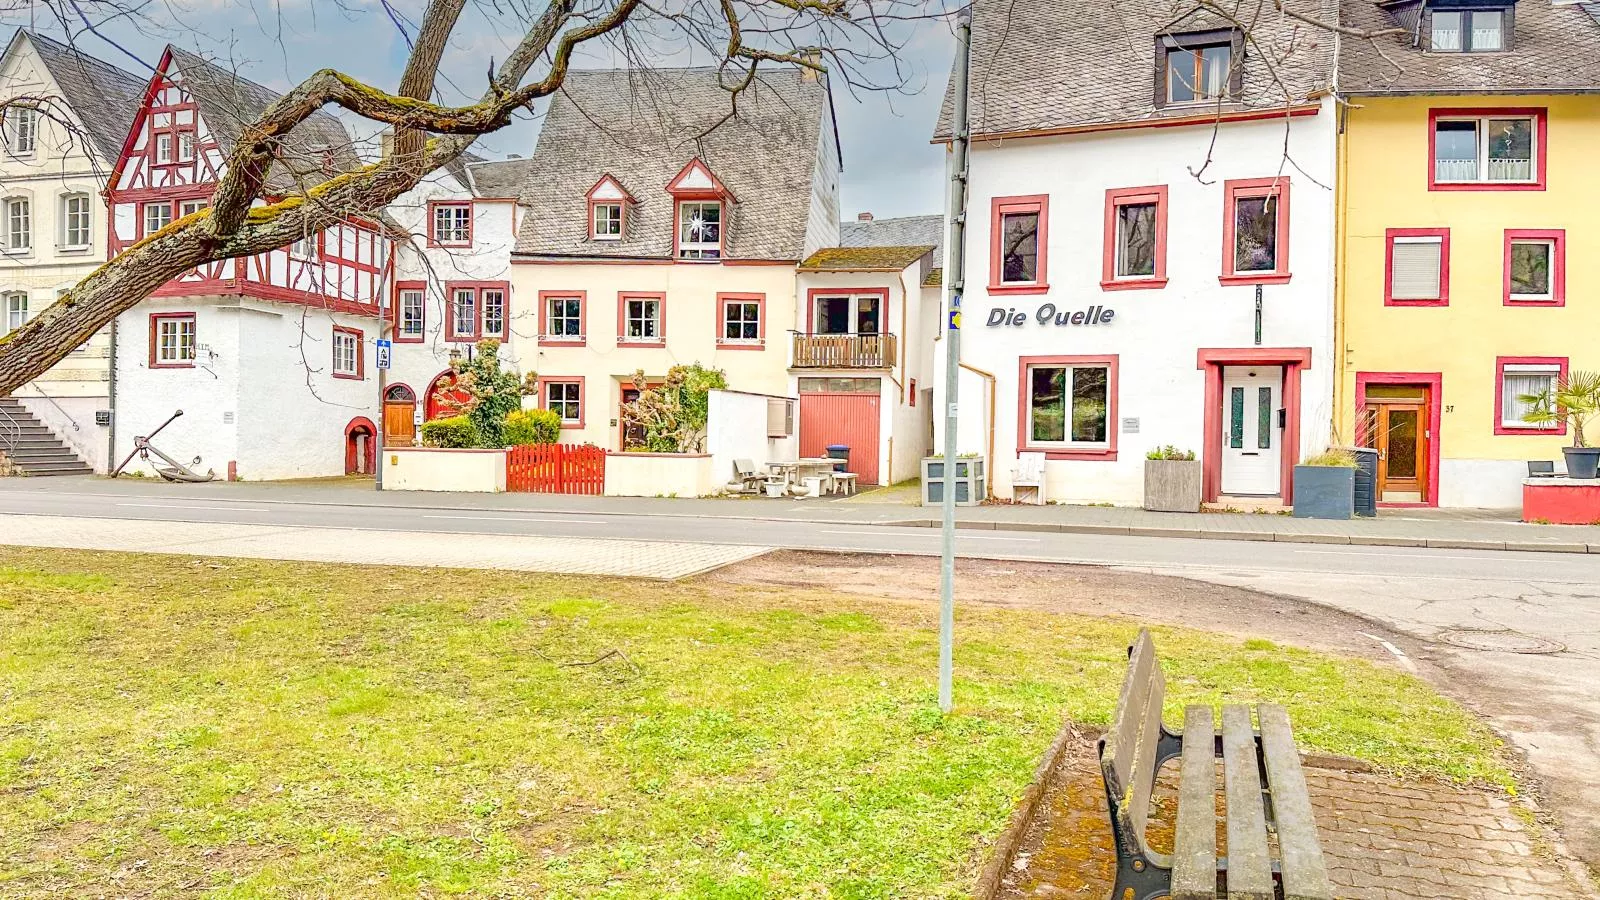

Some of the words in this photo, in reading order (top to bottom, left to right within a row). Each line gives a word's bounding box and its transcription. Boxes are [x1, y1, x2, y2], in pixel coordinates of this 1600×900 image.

[986, 308, 1027, 327] Die
[1035, 303, 1115, 326] Quelle
[1445, 405, 1455, 413] 37
